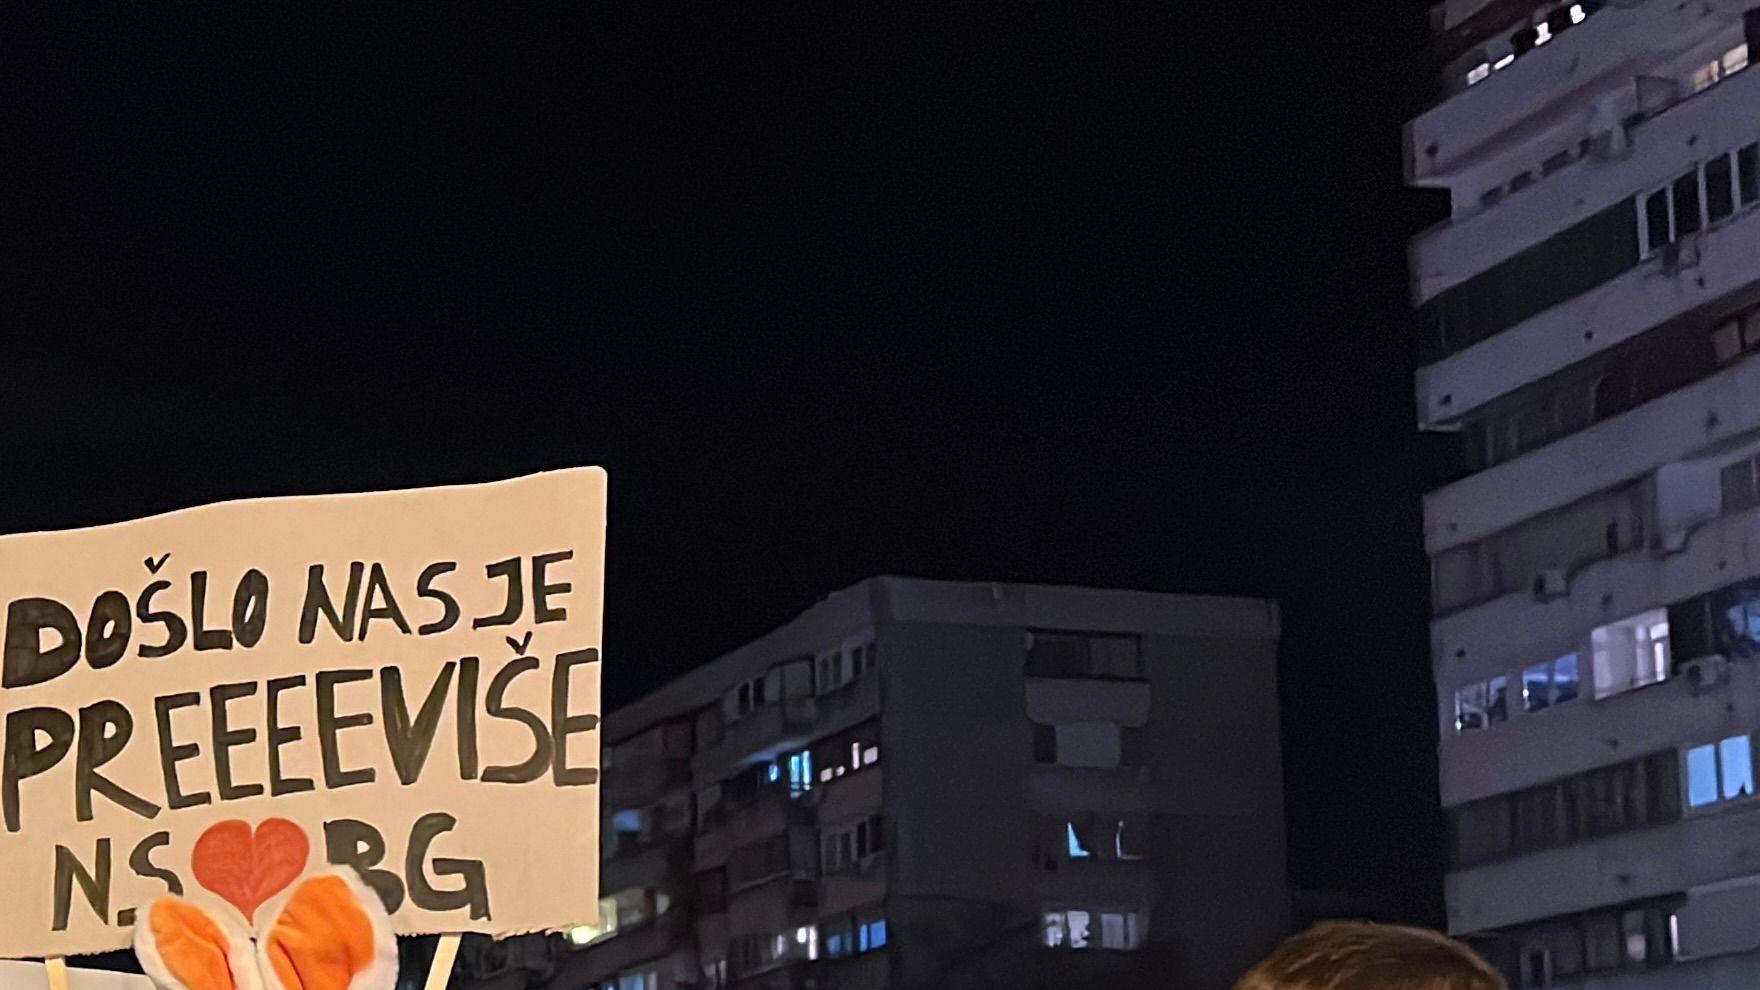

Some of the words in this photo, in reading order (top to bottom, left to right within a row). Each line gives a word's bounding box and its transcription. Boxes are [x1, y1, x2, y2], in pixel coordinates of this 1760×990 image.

[1, 553, 269, 689] DOŠLO
[298, 561, 460, 645] NAS
[473, 550, 574, 630] JE
[1, 631, 600, 832] PREEEEVIŠE
[51, 831, 182, 931] NS
[323, 812, 493, 922] BG
